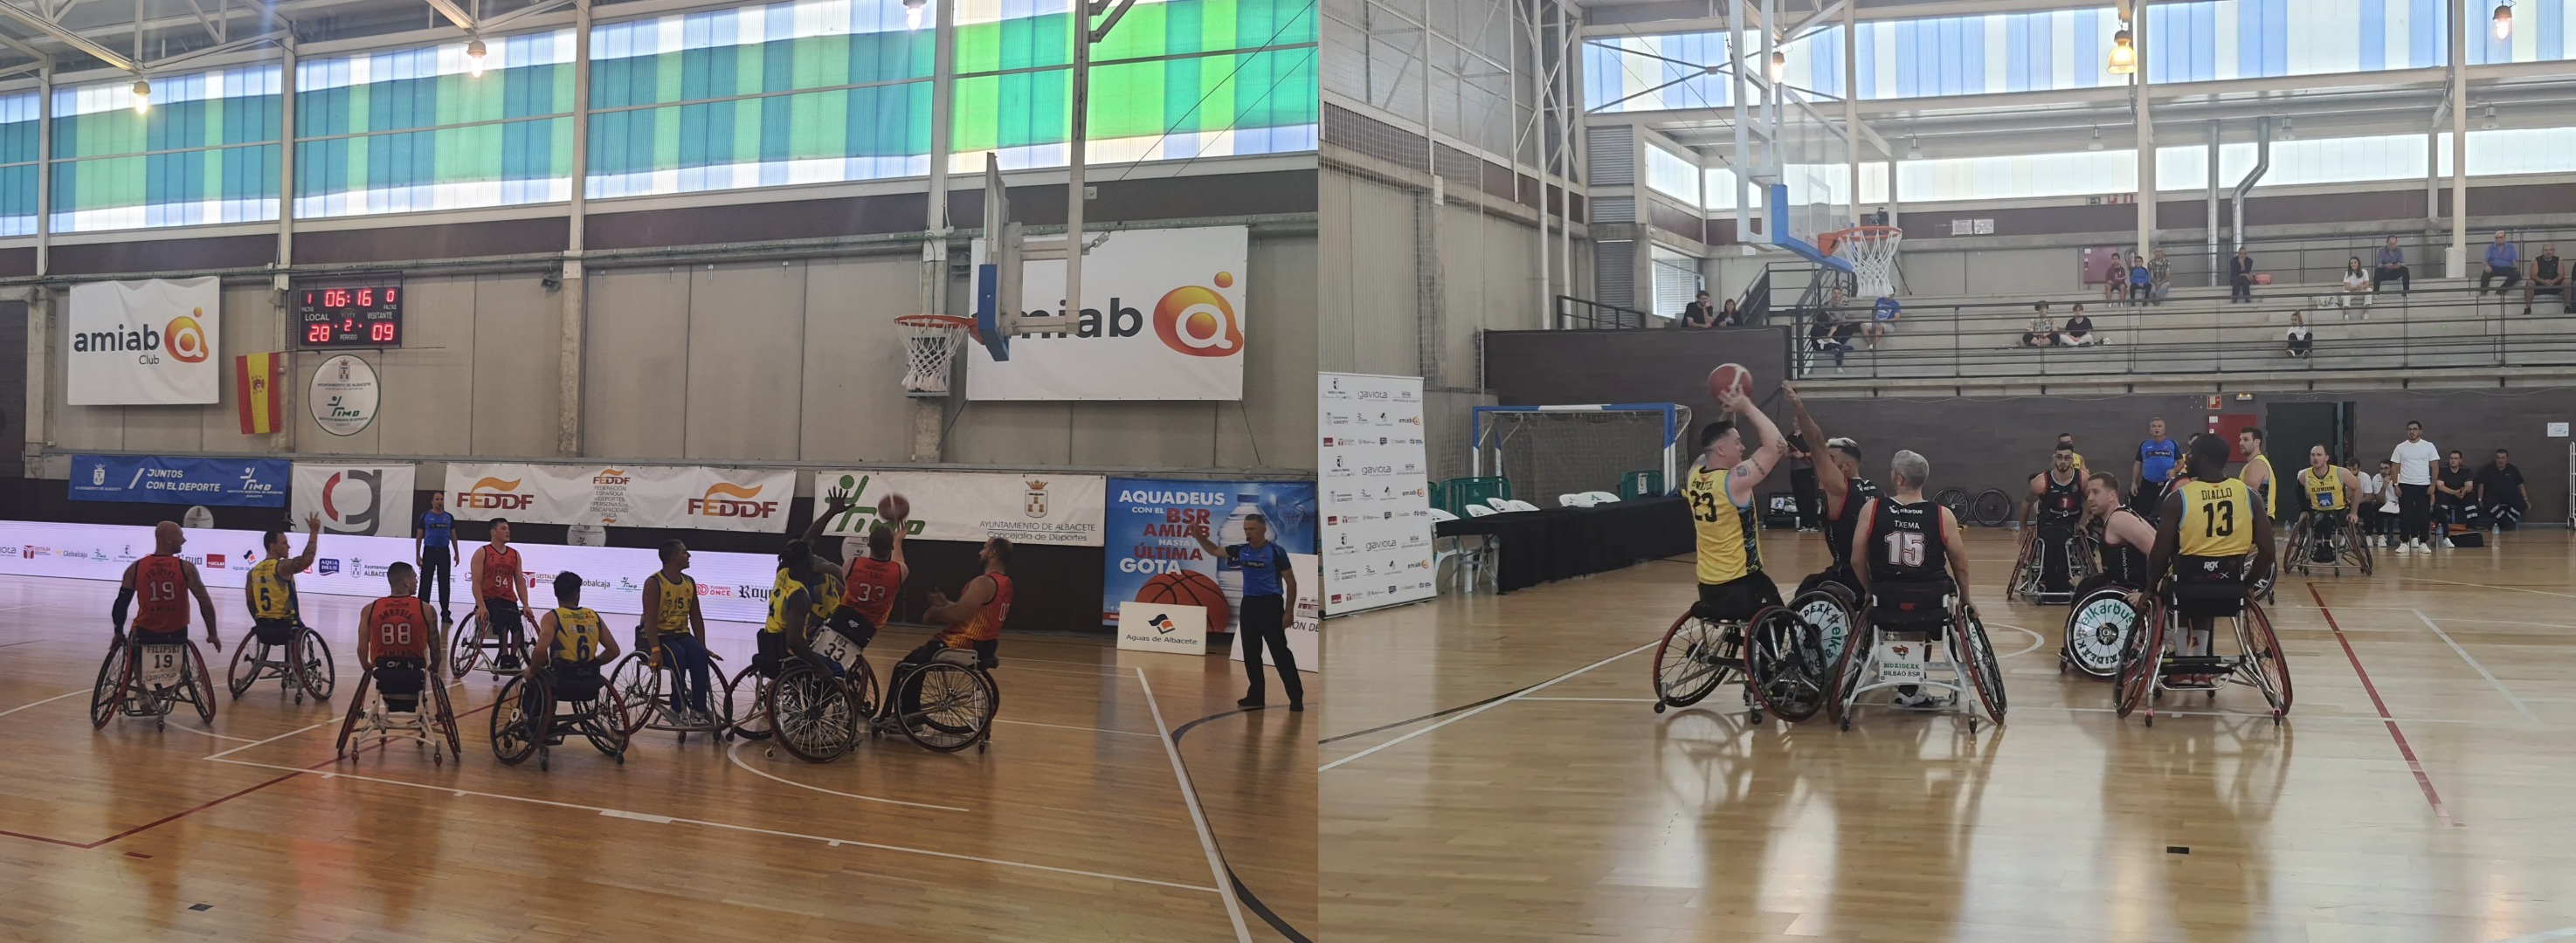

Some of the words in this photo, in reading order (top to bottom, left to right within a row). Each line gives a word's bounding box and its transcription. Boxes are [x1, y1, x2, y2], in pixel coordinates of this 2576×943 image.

[324, 290, 372, 307] 06:16
[305, 313, 330, 322] LOCAL
[367, 312, 393, 320] VISITANTE
[308, 325, 331, 342] 28
[344, 320, 353, 332] 2
[372, 323, 395, 341] 09
[73, 324, 160, 352] amiab
[139, 354, 160, 365] Club
[1357, 390, 1388, 400] gaviota
[147, 468, 183, 478] JUNTOS
[1361, 465, 1392, 475] gaviota
[146, 480, 165, 490] CON
[166, 481, 176, 491] EL
[178, 482, 220, 492] DEPORTE
[592, 476, 632, 485] FEDDF
[457, 492, 534, 510] FEDDF
[1119, 490, 1226, 506] AQUADEUS
[2200, 487, 2233, 500] DIALLO
[687, 498, 778, 519] FEDDF
[1689, 490, 1718, 522] 23
[1166, 507, 1211, 524] BSR
[2202, 500, 2234, 538] 13
[979, 521, 1040, 530] AYUNTAMIENTO
[1894, 520, 1921, 530] TXEMA
[1048, 533, 1088, 541] Deportes
[1134, 542, 1204, 561] ÚLTIMA
[1365, 540, 1397, 552] gaviota
[1884, 530, 1925, 568] 15
[63, 550, 88, 560] Globalcaja
[1119, 557, 1183, 575] GOTA
[494, 575, 509, 589] 94
[149, 581, 176, 602] 19
[857, 582, 887, 602] 33
[259, 587, 272, 612] 5
[674, 596, 684, 609] 15
[1803, 602, 1833, 618] DEAK
[381, 623, 411, 645] 88
[1164, 637, 1198, 645] Albacete
[147, 645, 180, 654] FILIPSKI
[577, 635, 590, 662] 6
[833, 635, 849, 649] FOX
[824, 643, 846, 662] 33
[155, 654, 173, 669] 19
